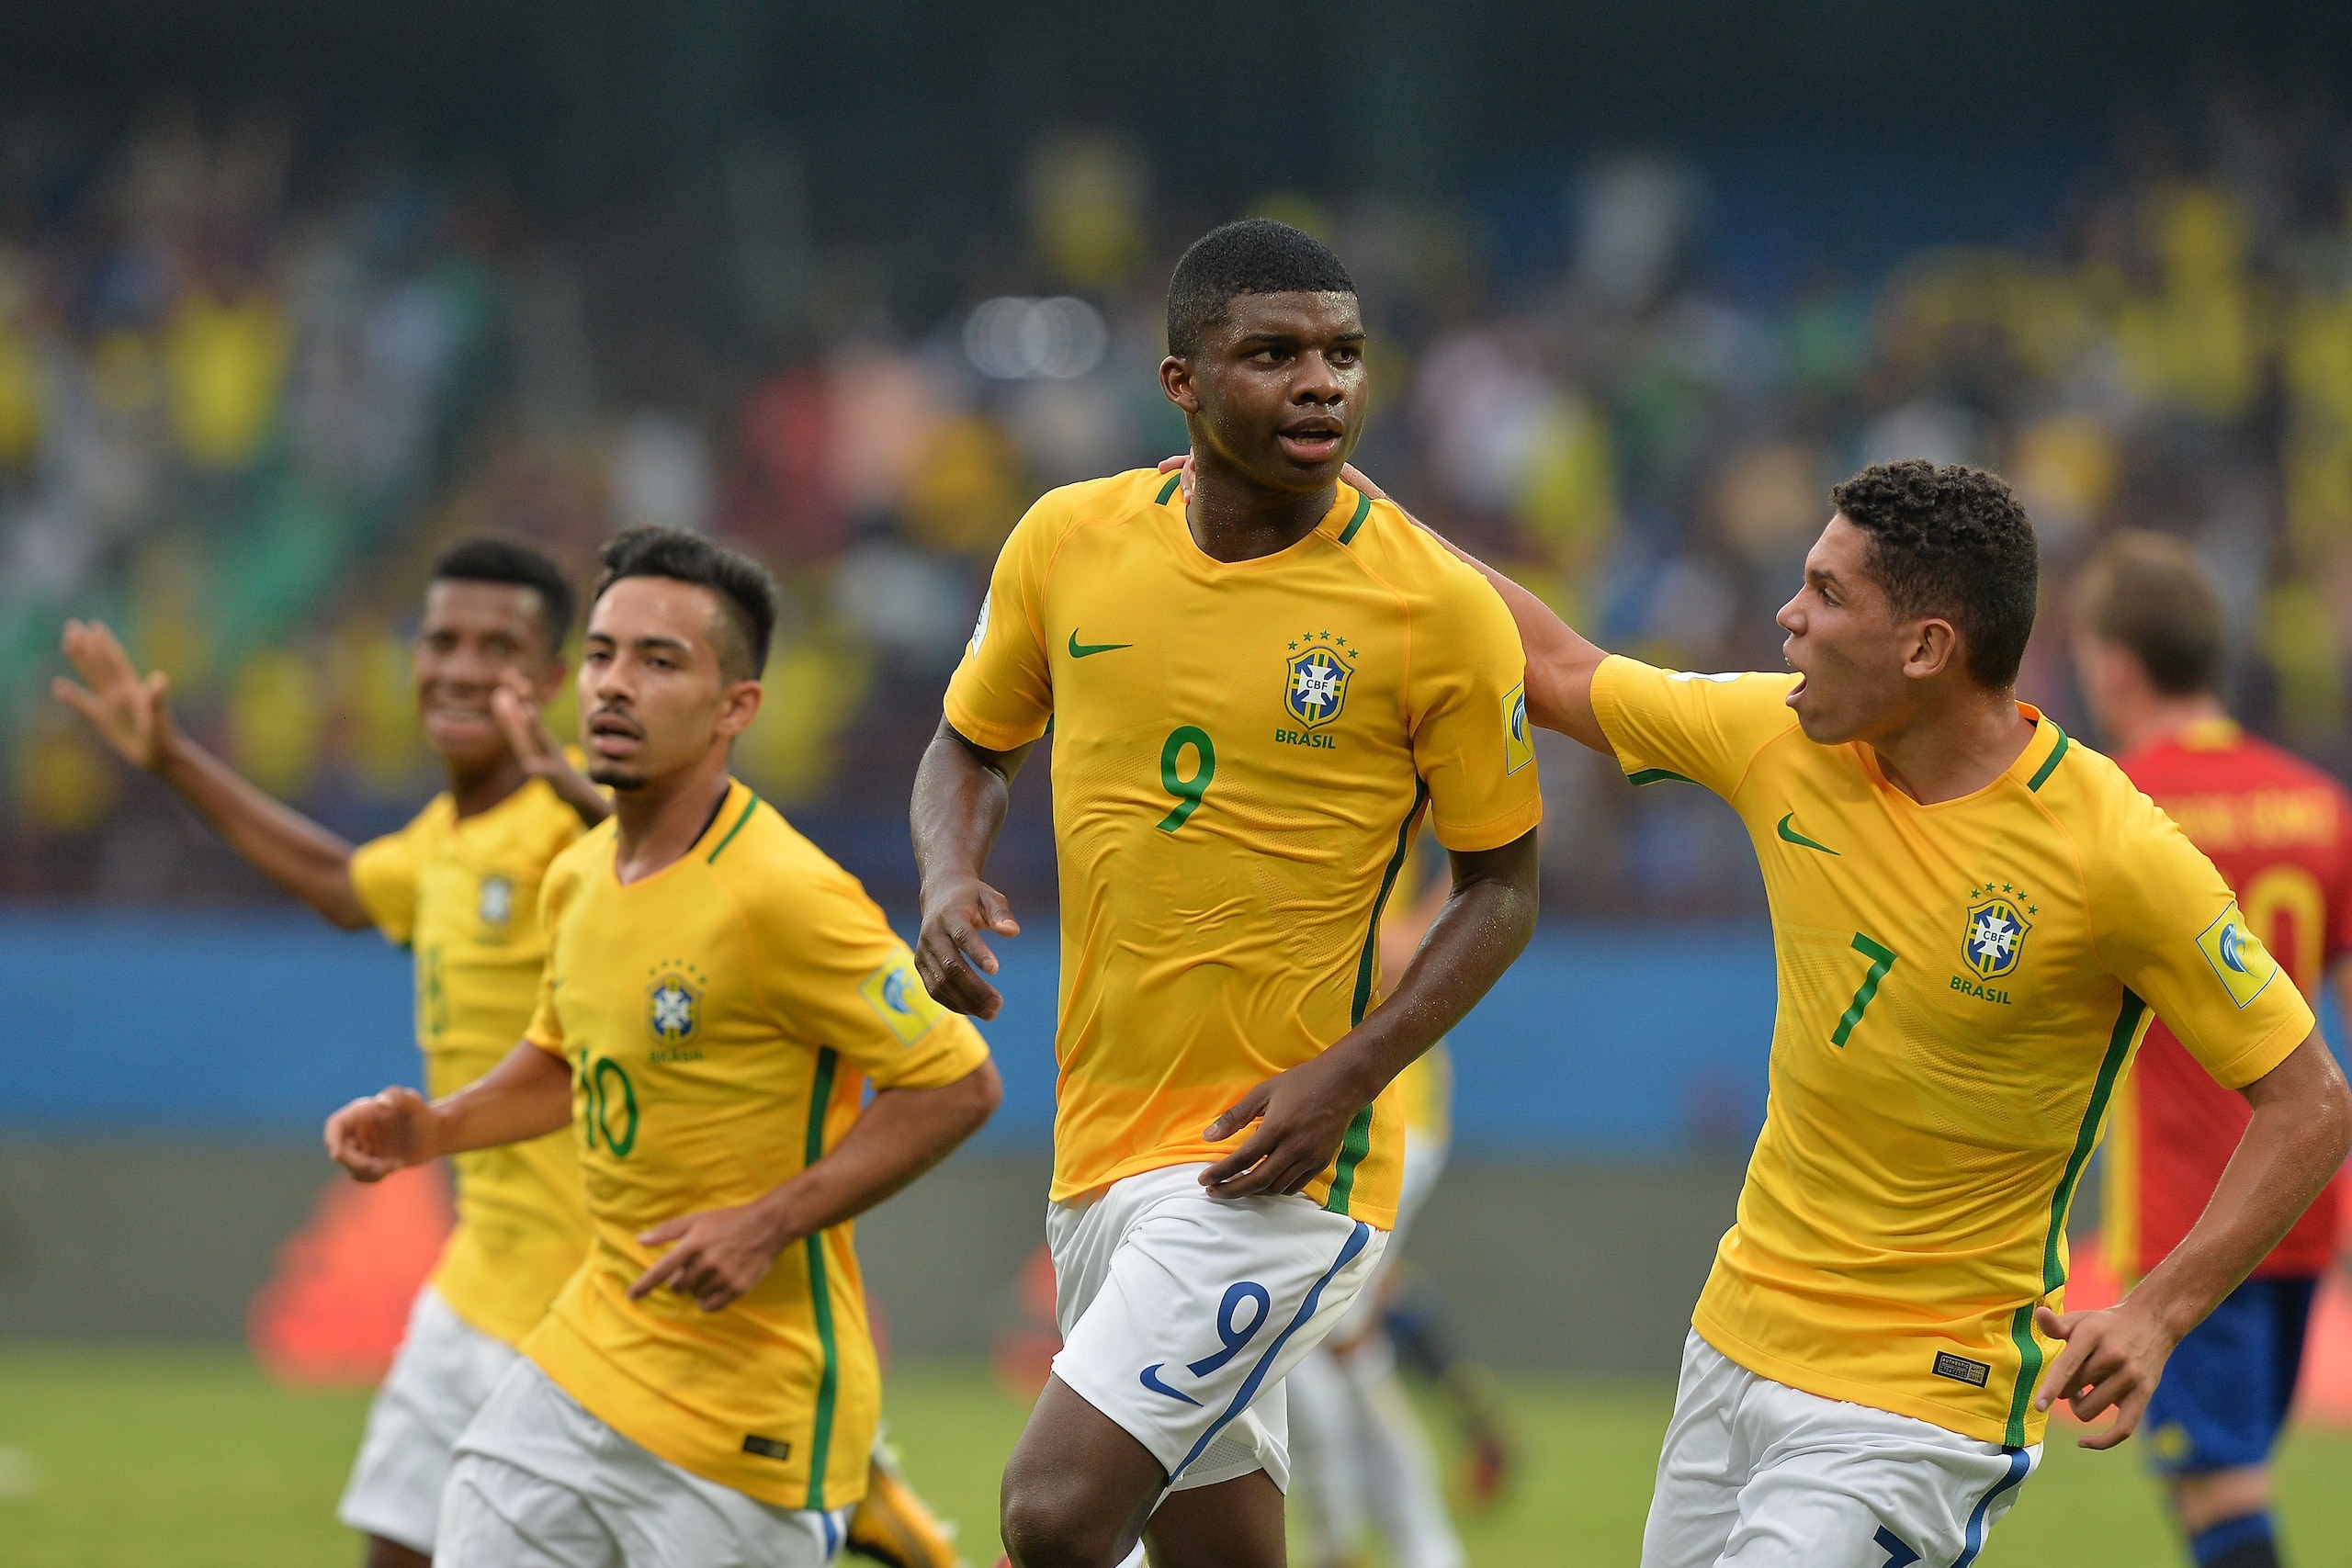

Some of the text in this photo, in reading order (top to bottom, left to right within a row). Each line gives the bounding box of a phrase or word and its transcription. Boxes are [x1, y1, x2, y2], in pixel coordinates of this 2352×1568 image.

[1306, 679, 1329, 691] CBF
[1274, 728, 1337, 750] BRASIL
[1156, 725, 1216, 833] 9
[1983, 931, 2005, 943] CBF
[1830, 931, 1898, 1048] 7
[1950, 975, 2012, 1005] BRASIL
[580, 1049, 639, 1157] 10
[1186, 1281, 1271, 1378] 9
